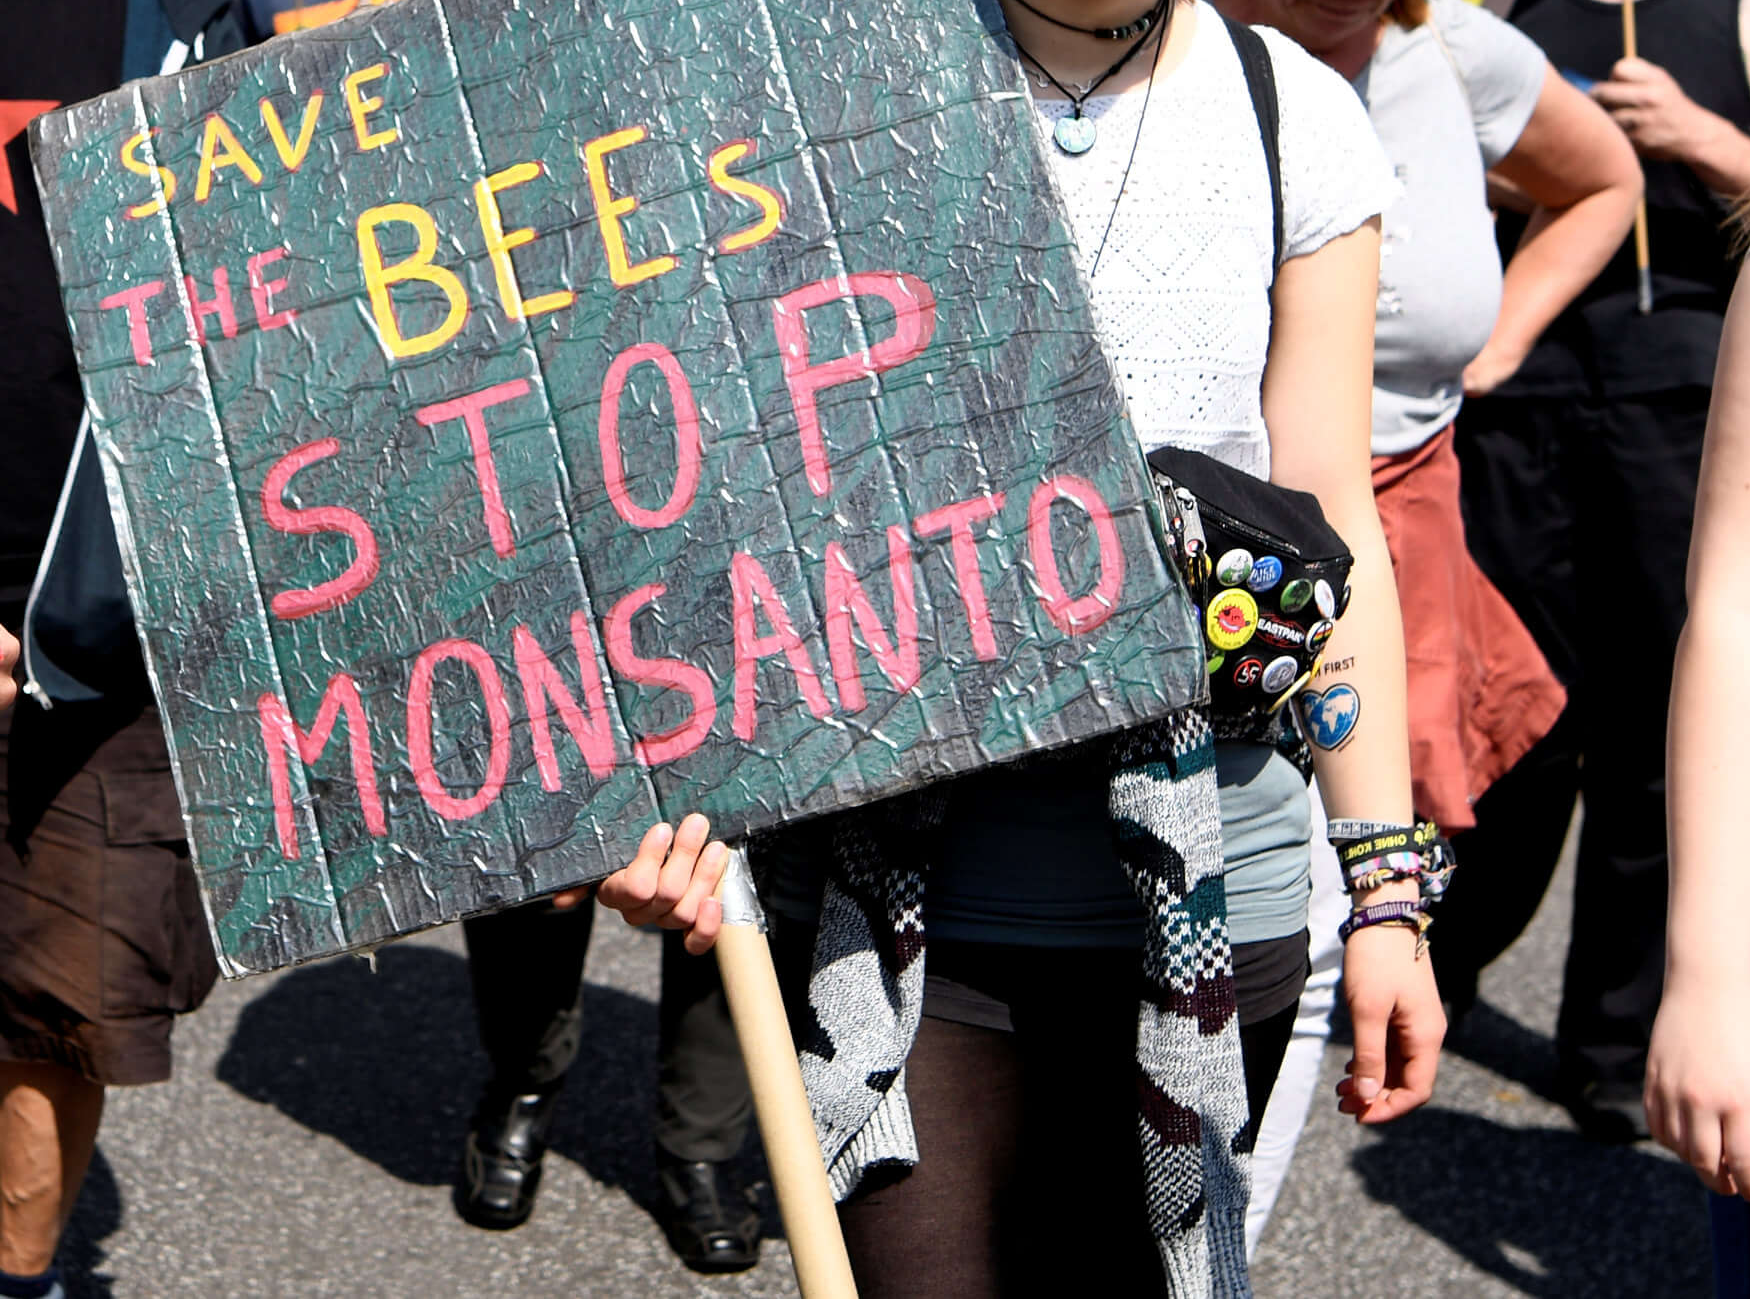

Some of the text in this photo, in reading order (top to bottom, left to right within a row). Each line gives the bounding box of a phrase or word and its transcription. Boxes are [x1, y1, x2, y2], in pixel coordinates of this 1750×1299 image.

[119, 62, 401, 220] SAVE
[100, 245, 299, 366] THE
[260, 269, 937, 620] STOP
[256, 474, 1126, 860] MONSANTO
[1257, 618, 1302, 644] EASTPAK
[1323, 656, 1356, 675] FIRST
